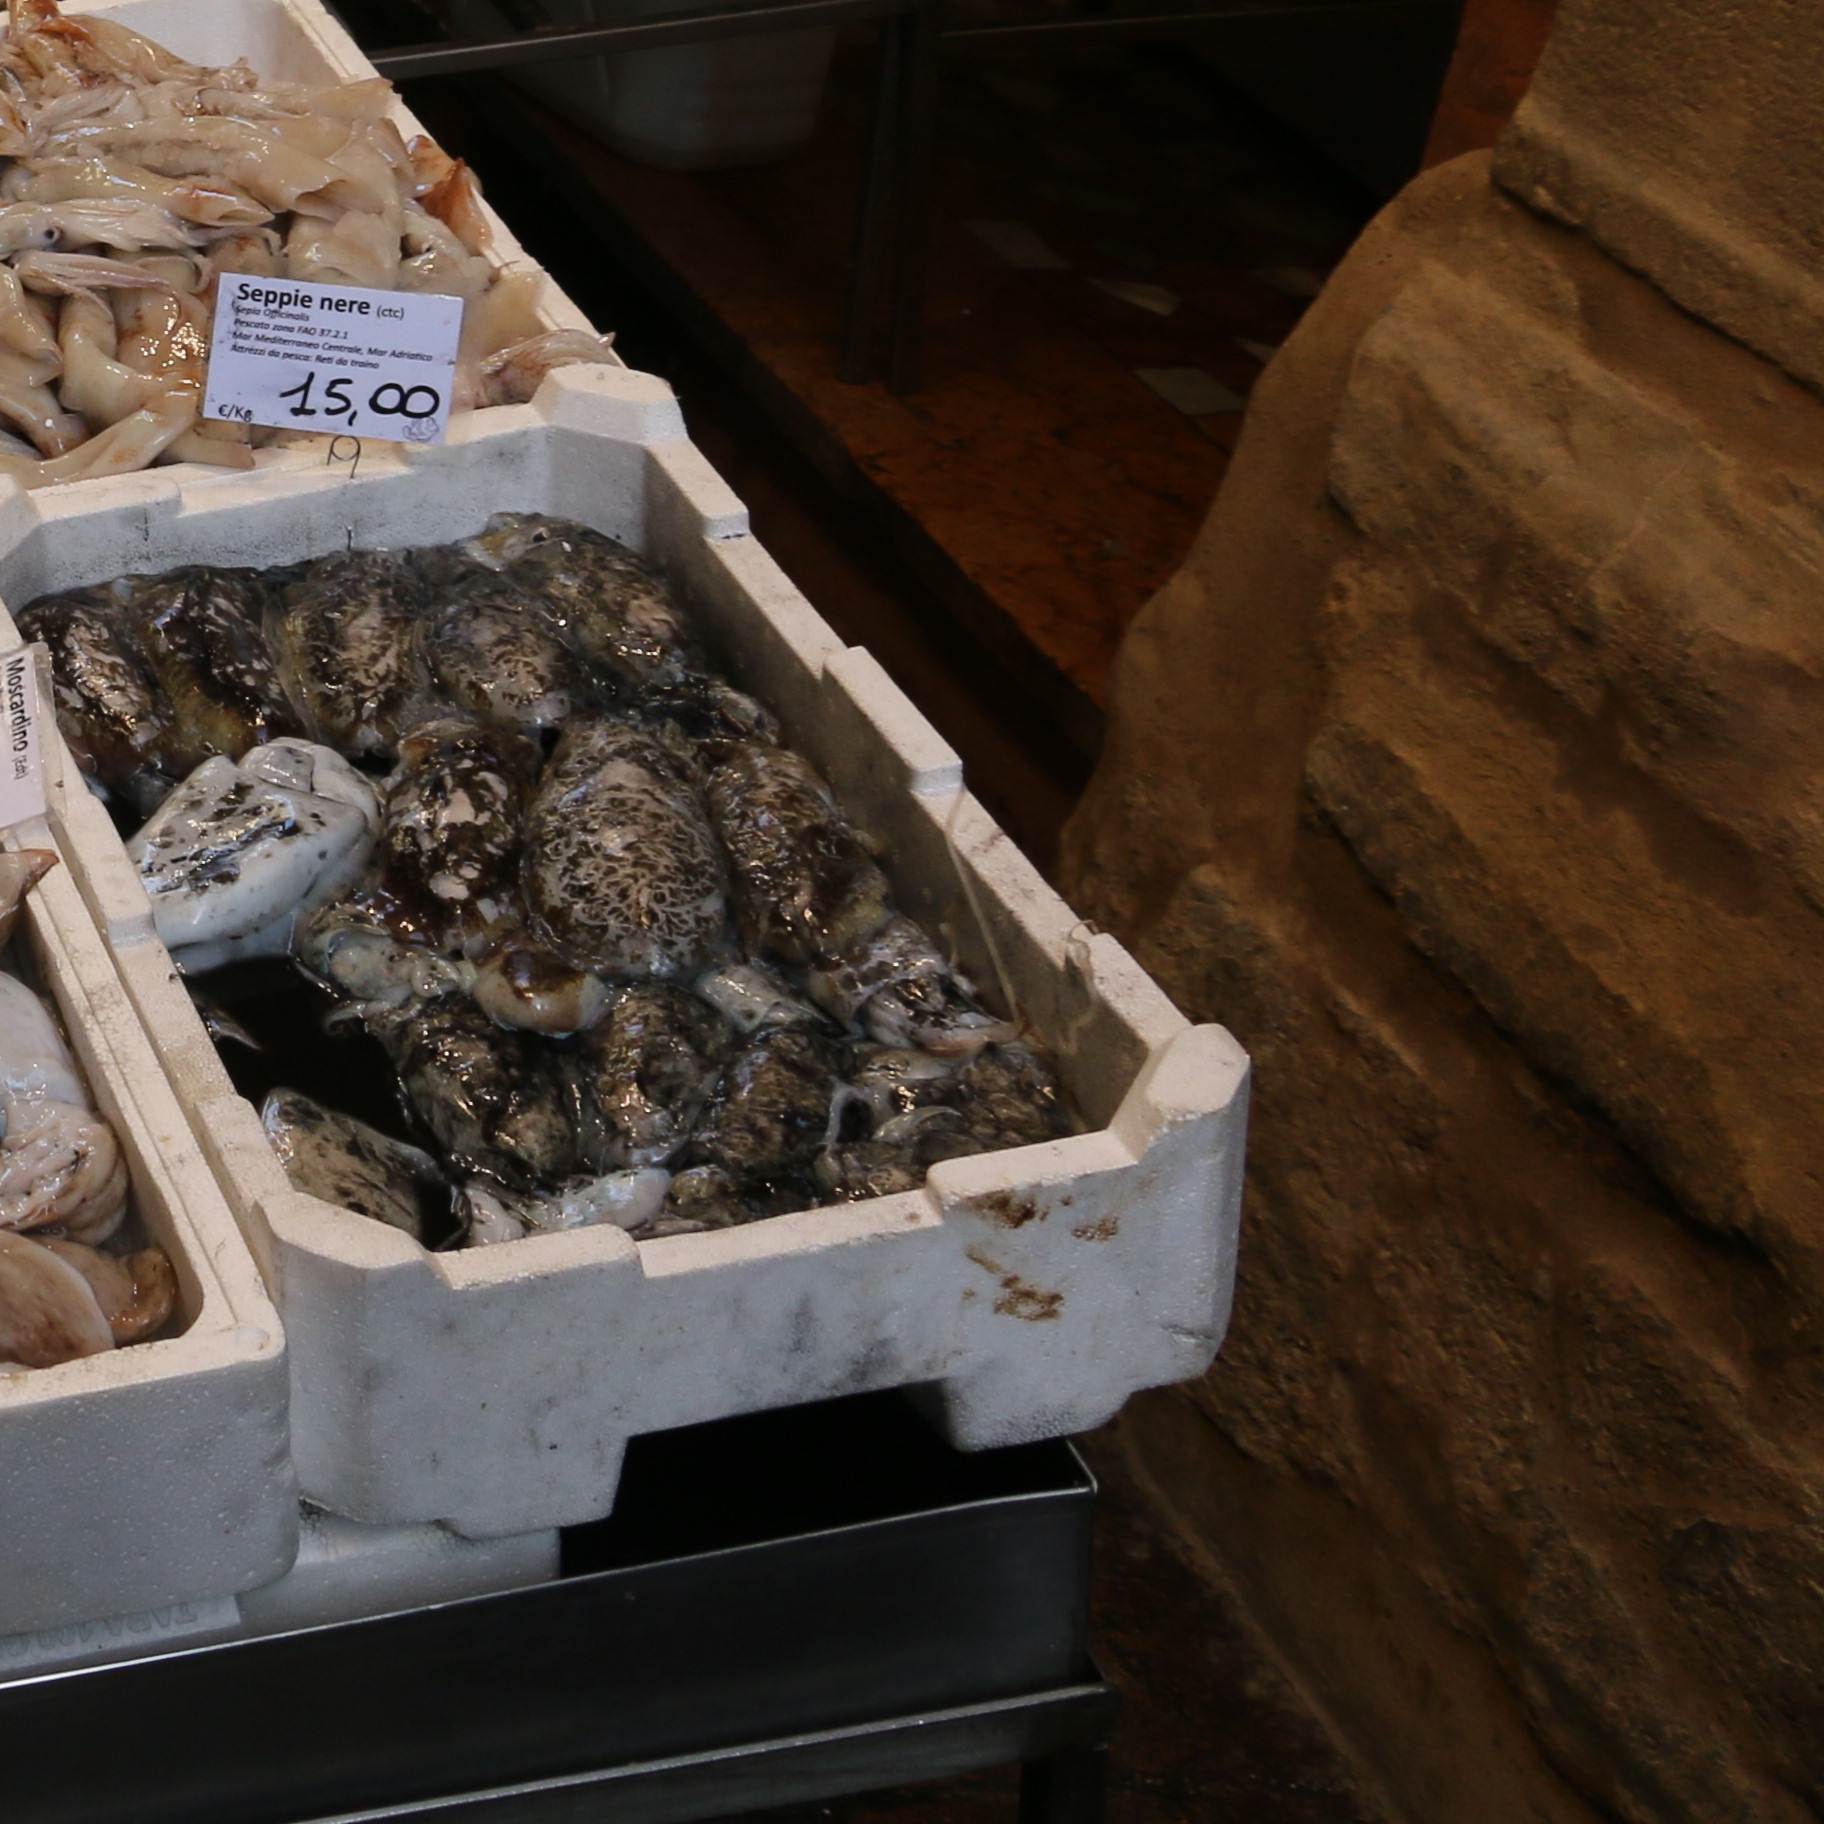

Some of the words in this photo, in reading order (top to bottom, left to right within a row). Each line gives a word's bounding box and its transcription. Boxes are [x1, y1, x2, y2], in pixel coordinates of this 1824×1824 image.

[236, 282, 314, 311] Seppie
[318, 295, 371, 315] nere
[375, 305, 405, 320] (ctc)
[262, 308, 311, 322] Officinalis
[233, 318, 270, 330] Pescato
[271, 324, 295, 333] zona
[296, 325, 316, 335] FAO
[317, 328, 348, 339] 37.2.1
[232, 330, 253, 341] Mar
[253, 334, 320, 349] Mediterraneo
[321, 341, 365, 356] Centrale,
[366, 347, 387, 356] Mar
[388, 349, 433, 362] Adriatico
[267, 349, 280, 358] da
[281, 351, 313, 363] pesca:
[314, 354, 333, 364] Reti
[334, 356, 348, 365] da
[349, 358, 380, 369] traino
[278, 371, 441, 427] 15,00
[216, 403, 254, 422] €/Kg
[5, 656, 32, 752] Moscardino
